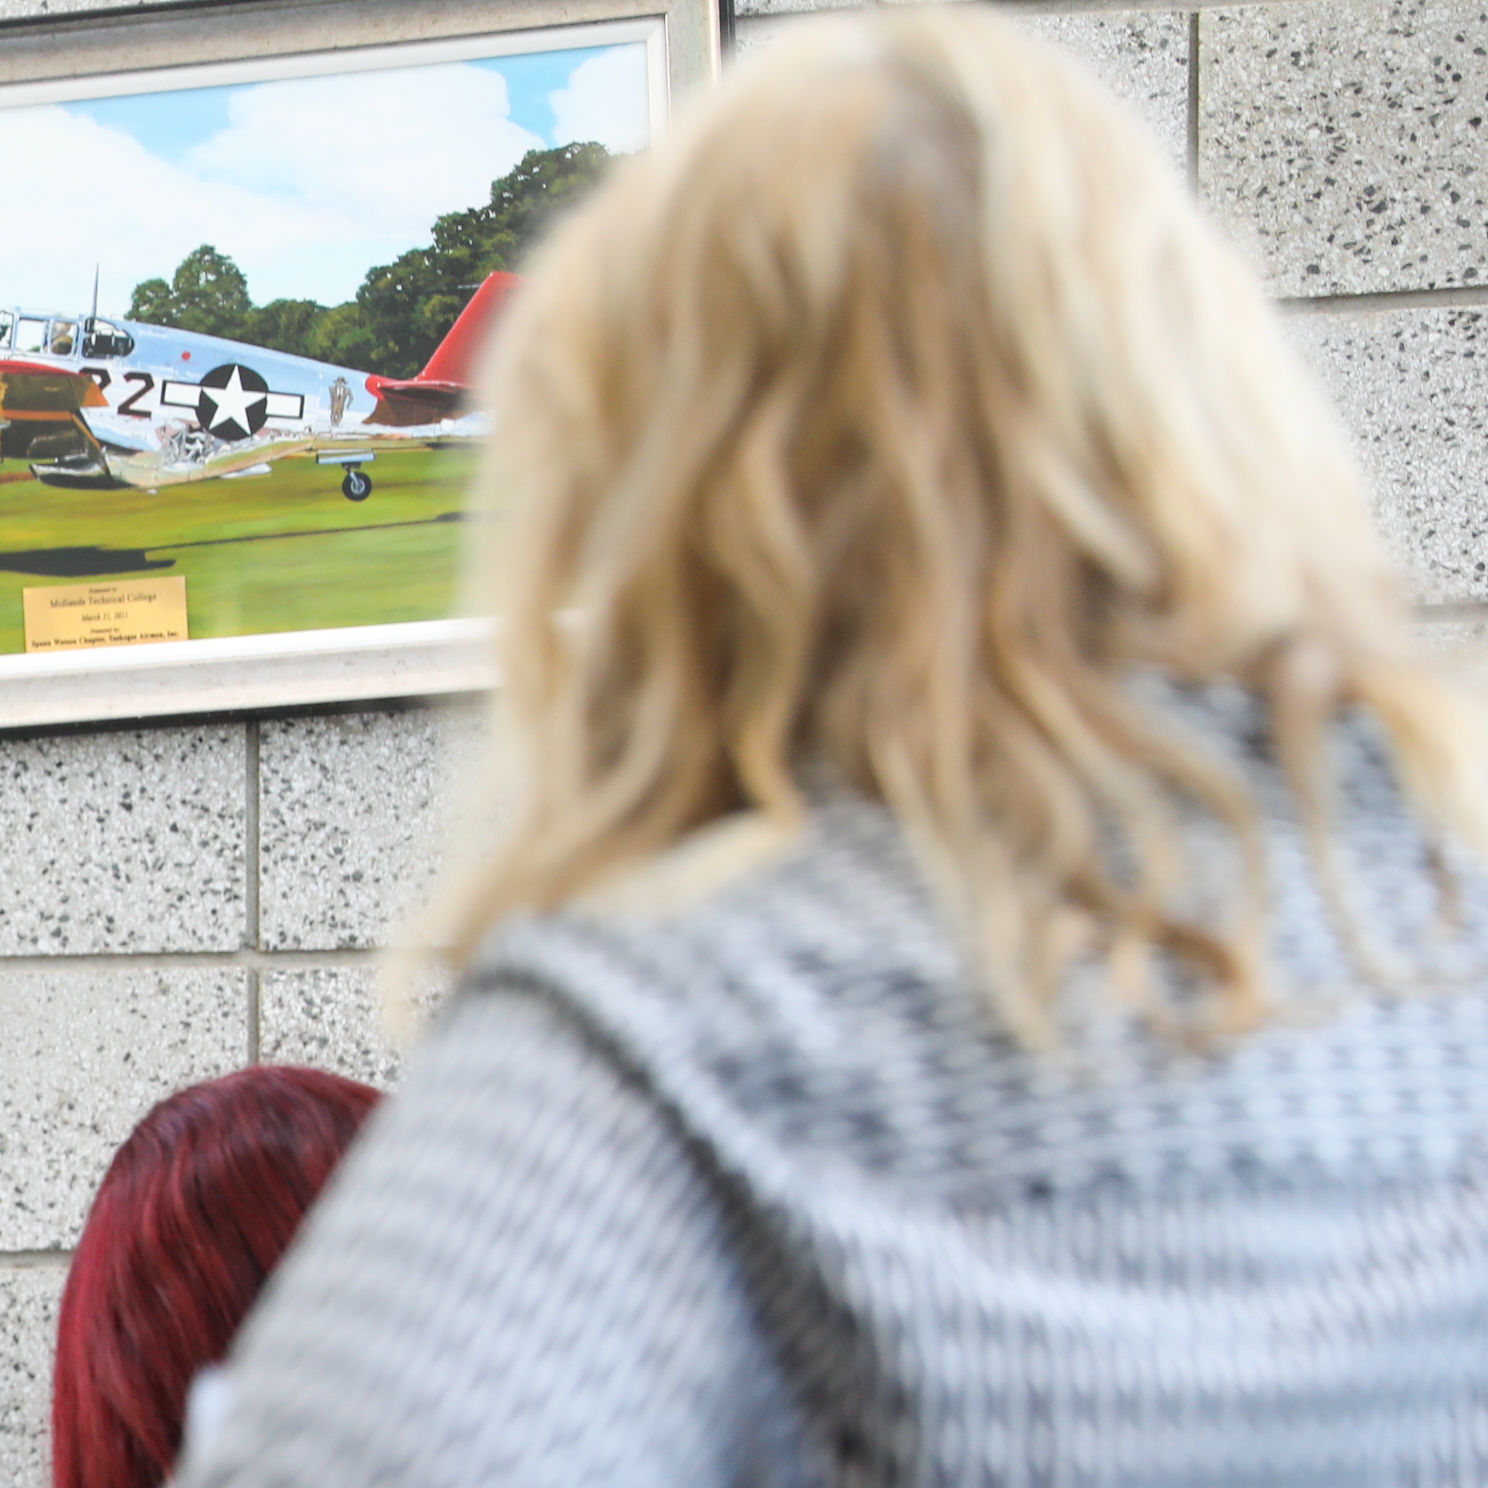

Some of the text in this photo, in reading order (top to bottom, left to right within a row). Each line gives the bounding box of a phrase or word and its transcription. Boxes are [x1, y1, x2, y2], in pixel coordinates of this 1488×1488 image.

[50, 593, 157, 608] Midlands Technical College
[81, 613, 101, 622] March
